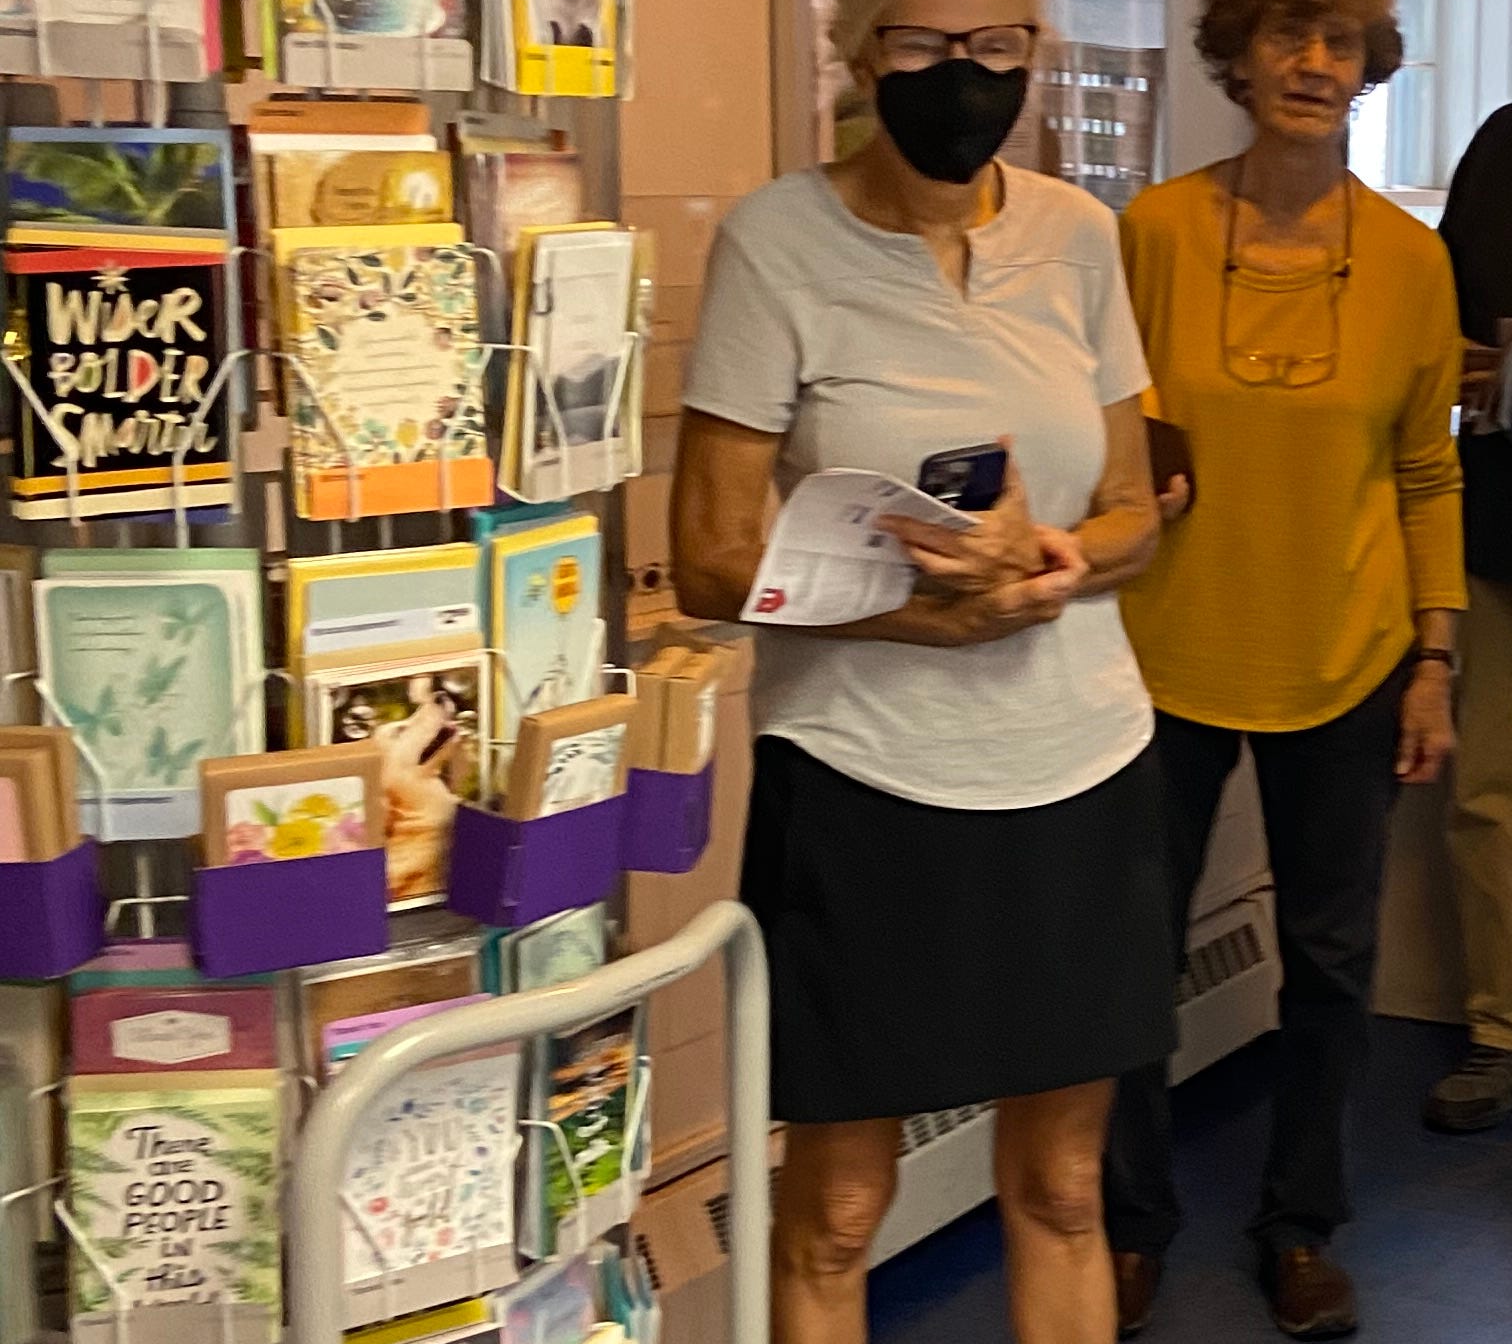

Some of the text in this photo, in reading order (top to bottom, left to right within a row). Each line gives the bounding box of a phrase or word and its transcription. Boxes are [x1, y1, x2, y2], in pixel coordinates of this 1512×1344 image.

[123, 1124, 213, 1160] There
[124, 1179, 225, 1208] GOOD
[123, 1204, 233, 1238] PEOPLE
